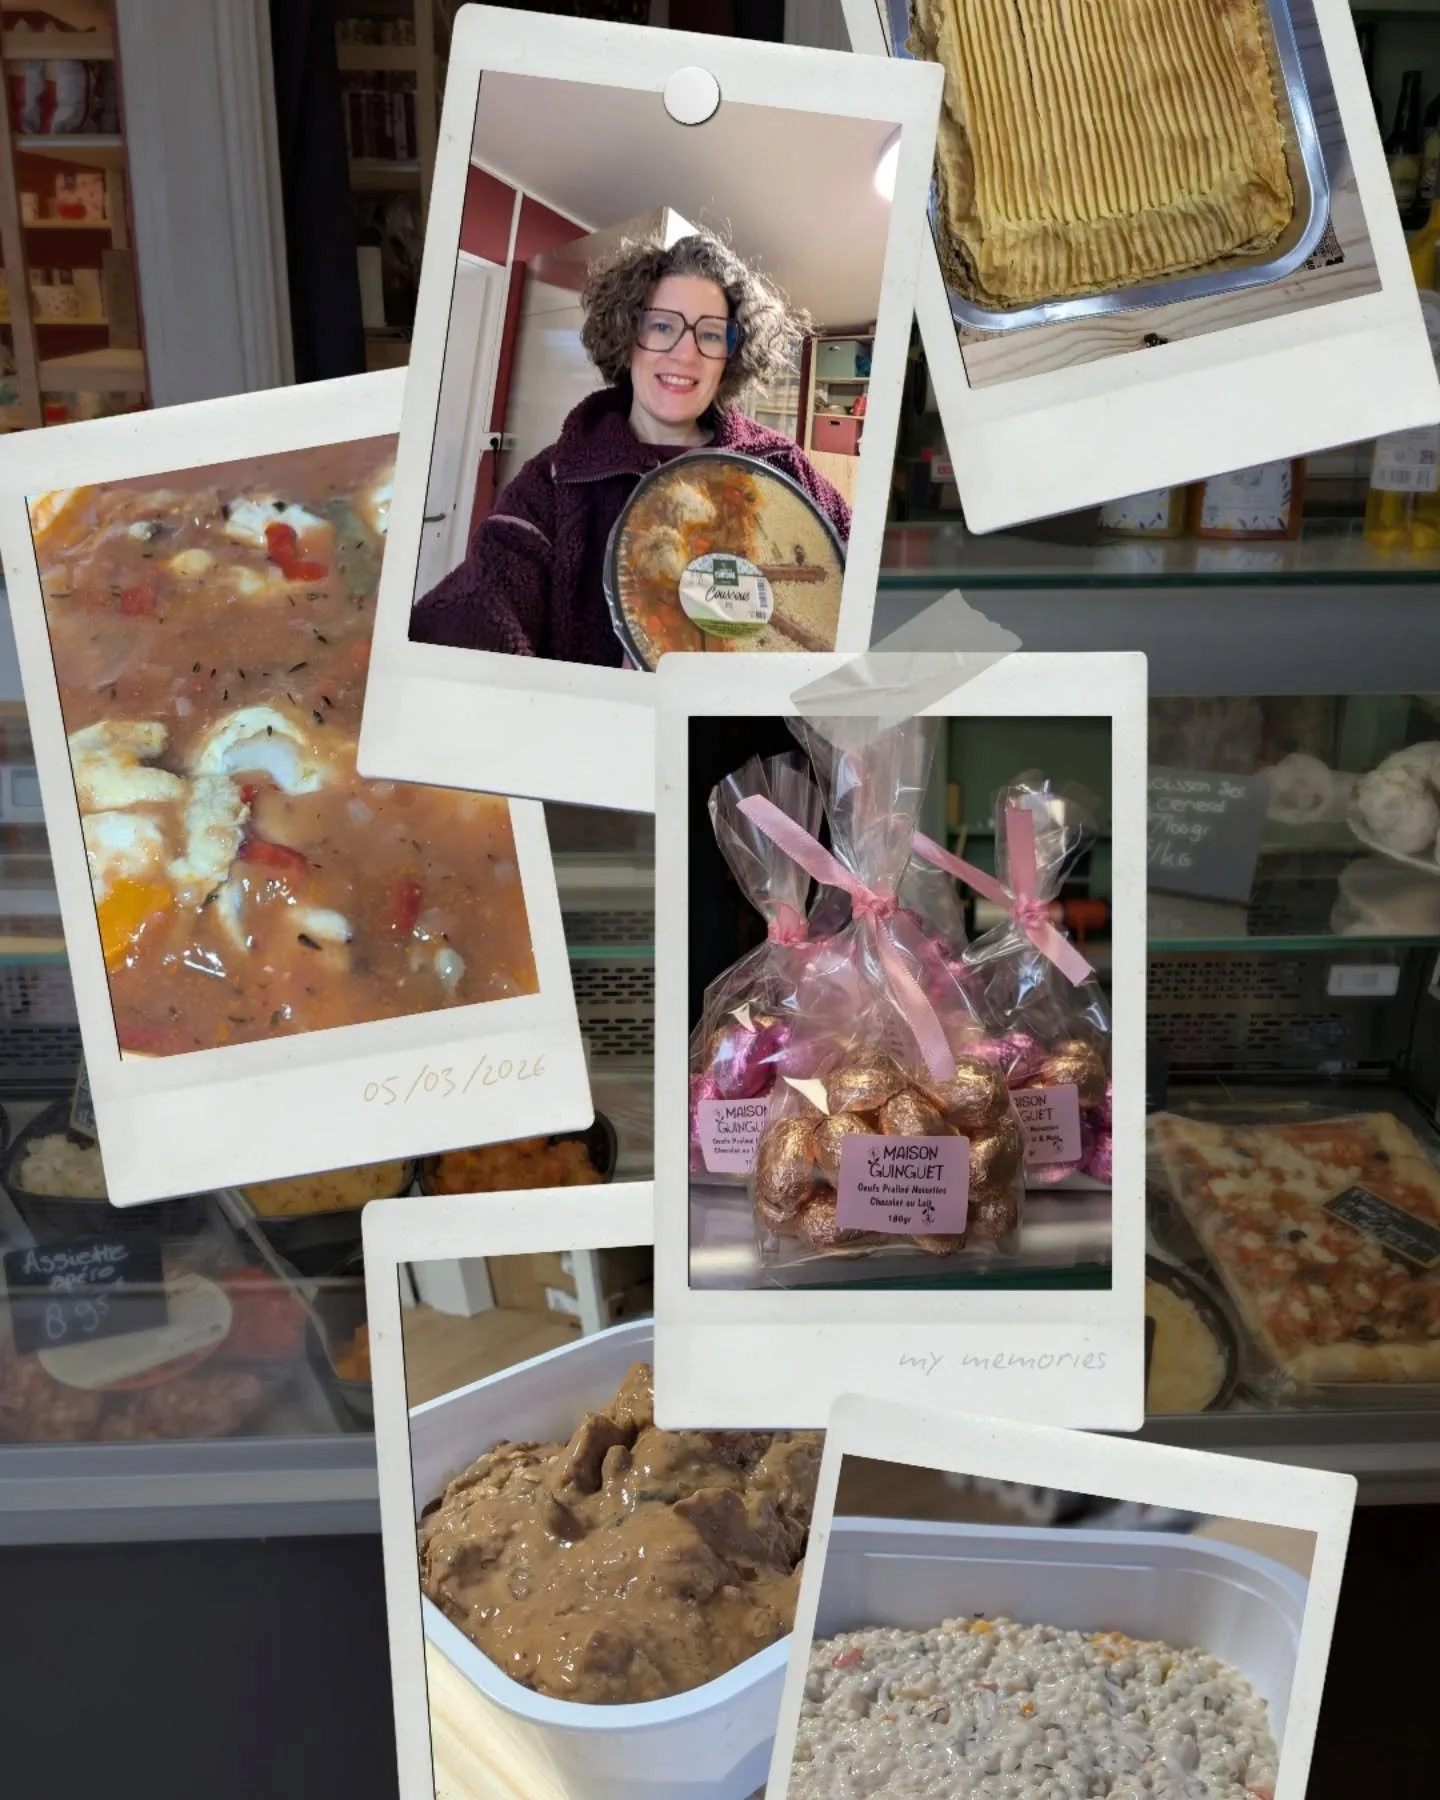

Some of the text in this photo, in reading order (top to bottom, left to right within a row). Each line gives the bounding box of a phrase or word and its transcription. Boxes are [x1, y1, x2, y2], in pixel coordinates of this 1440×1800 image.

[1020, 1107, 1054, 1122] GUET
[883, 1145, 938, 1161] MAISON
[869, 1164, 945, 1181] GUINGUET
[857, 1182, 880, 1193] Oeufs
